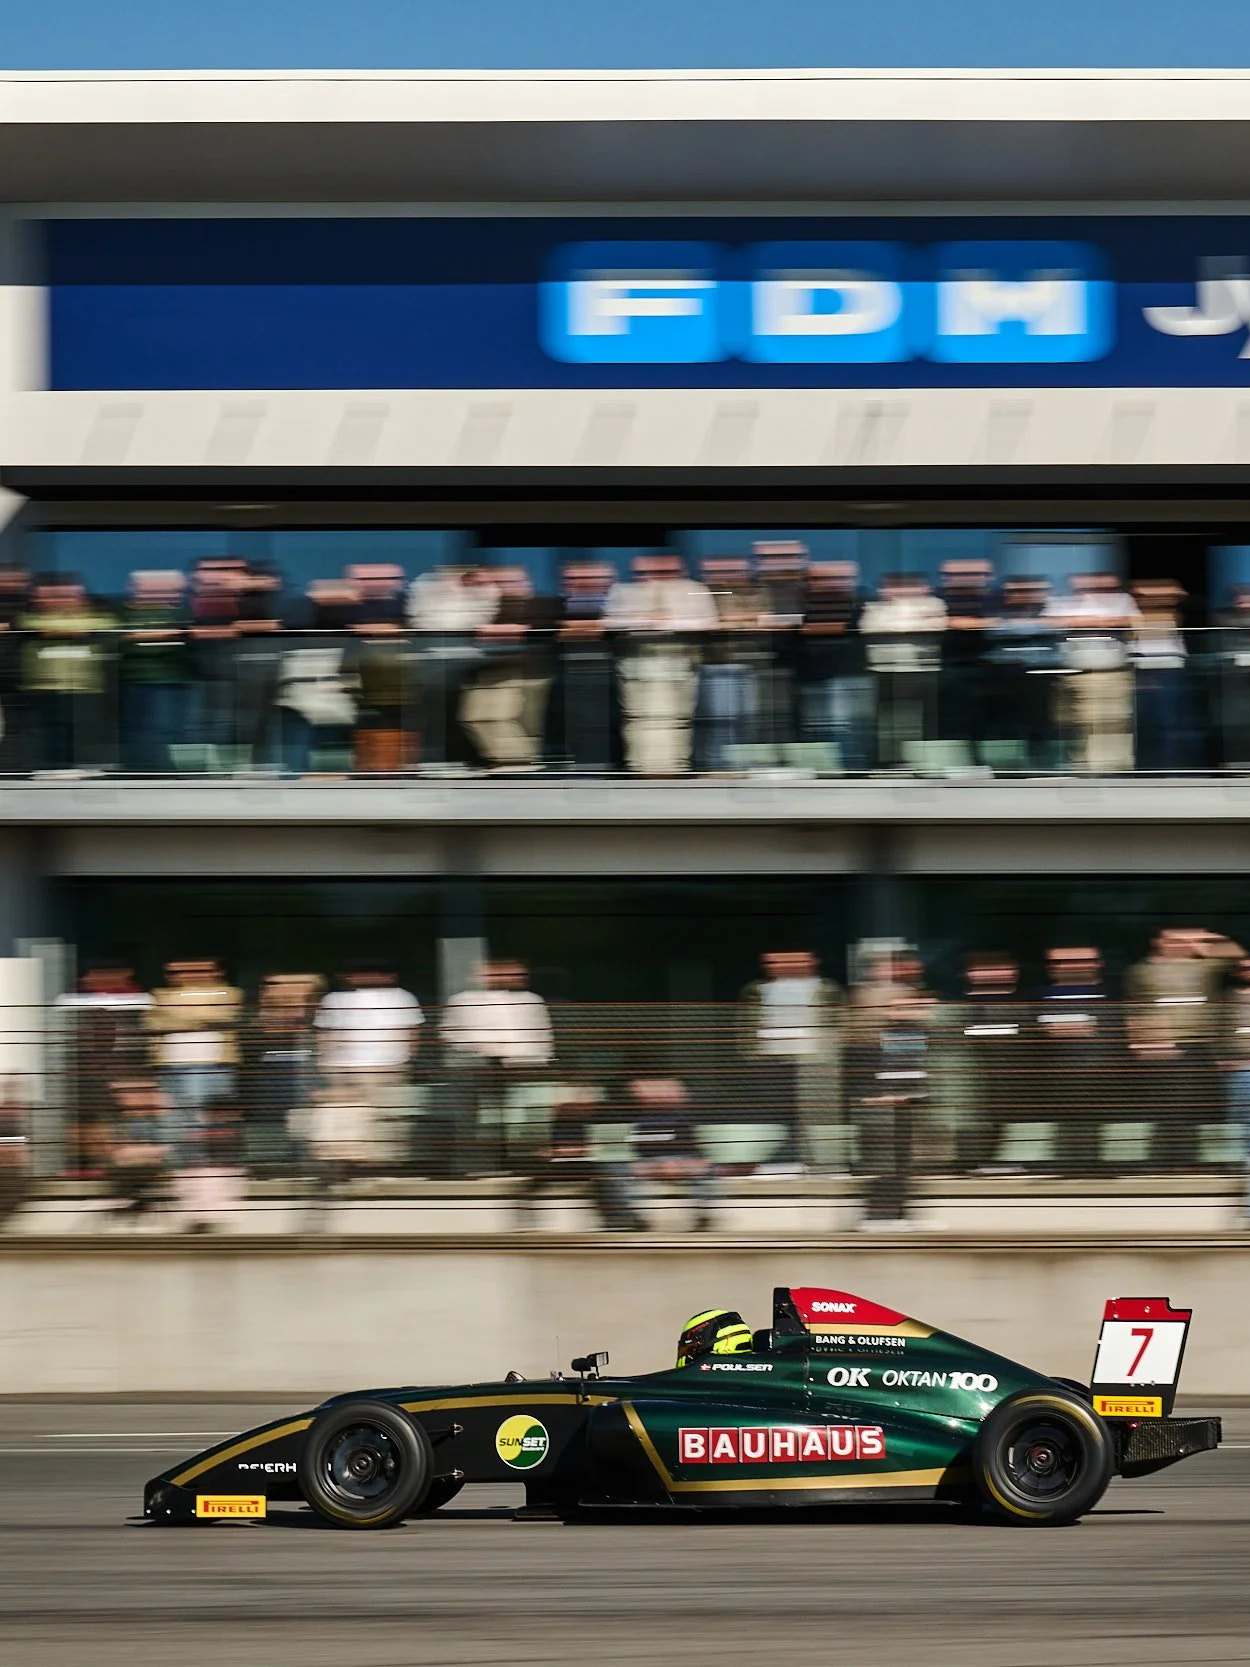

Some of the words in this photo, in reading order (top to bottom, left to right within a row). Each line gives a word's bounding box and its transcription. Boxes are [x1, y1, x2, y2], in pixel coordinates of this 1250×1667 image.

[566, 269, 1088, 335] FDM
[811, 1301, 857, 1313] SONAX
[815, 1335, 846, 1345] BANG
[848, 1336, 856, 1345] &
[857, 1336, 906, 1347] OLUFSEN
[1126, 1328, 1154, 1376] 7
[711, 1363, 774, 1372] POULSEN
[826, 1367, 872, 1387] OK
[1101, 1401, 1155, 1412] PIRELLI
[498, 1437, 547, 1447] SUNSET
[684, 1429, 883, 1459] BAUHAUS
[203, 1501, 259, 1512] PIRELLI
